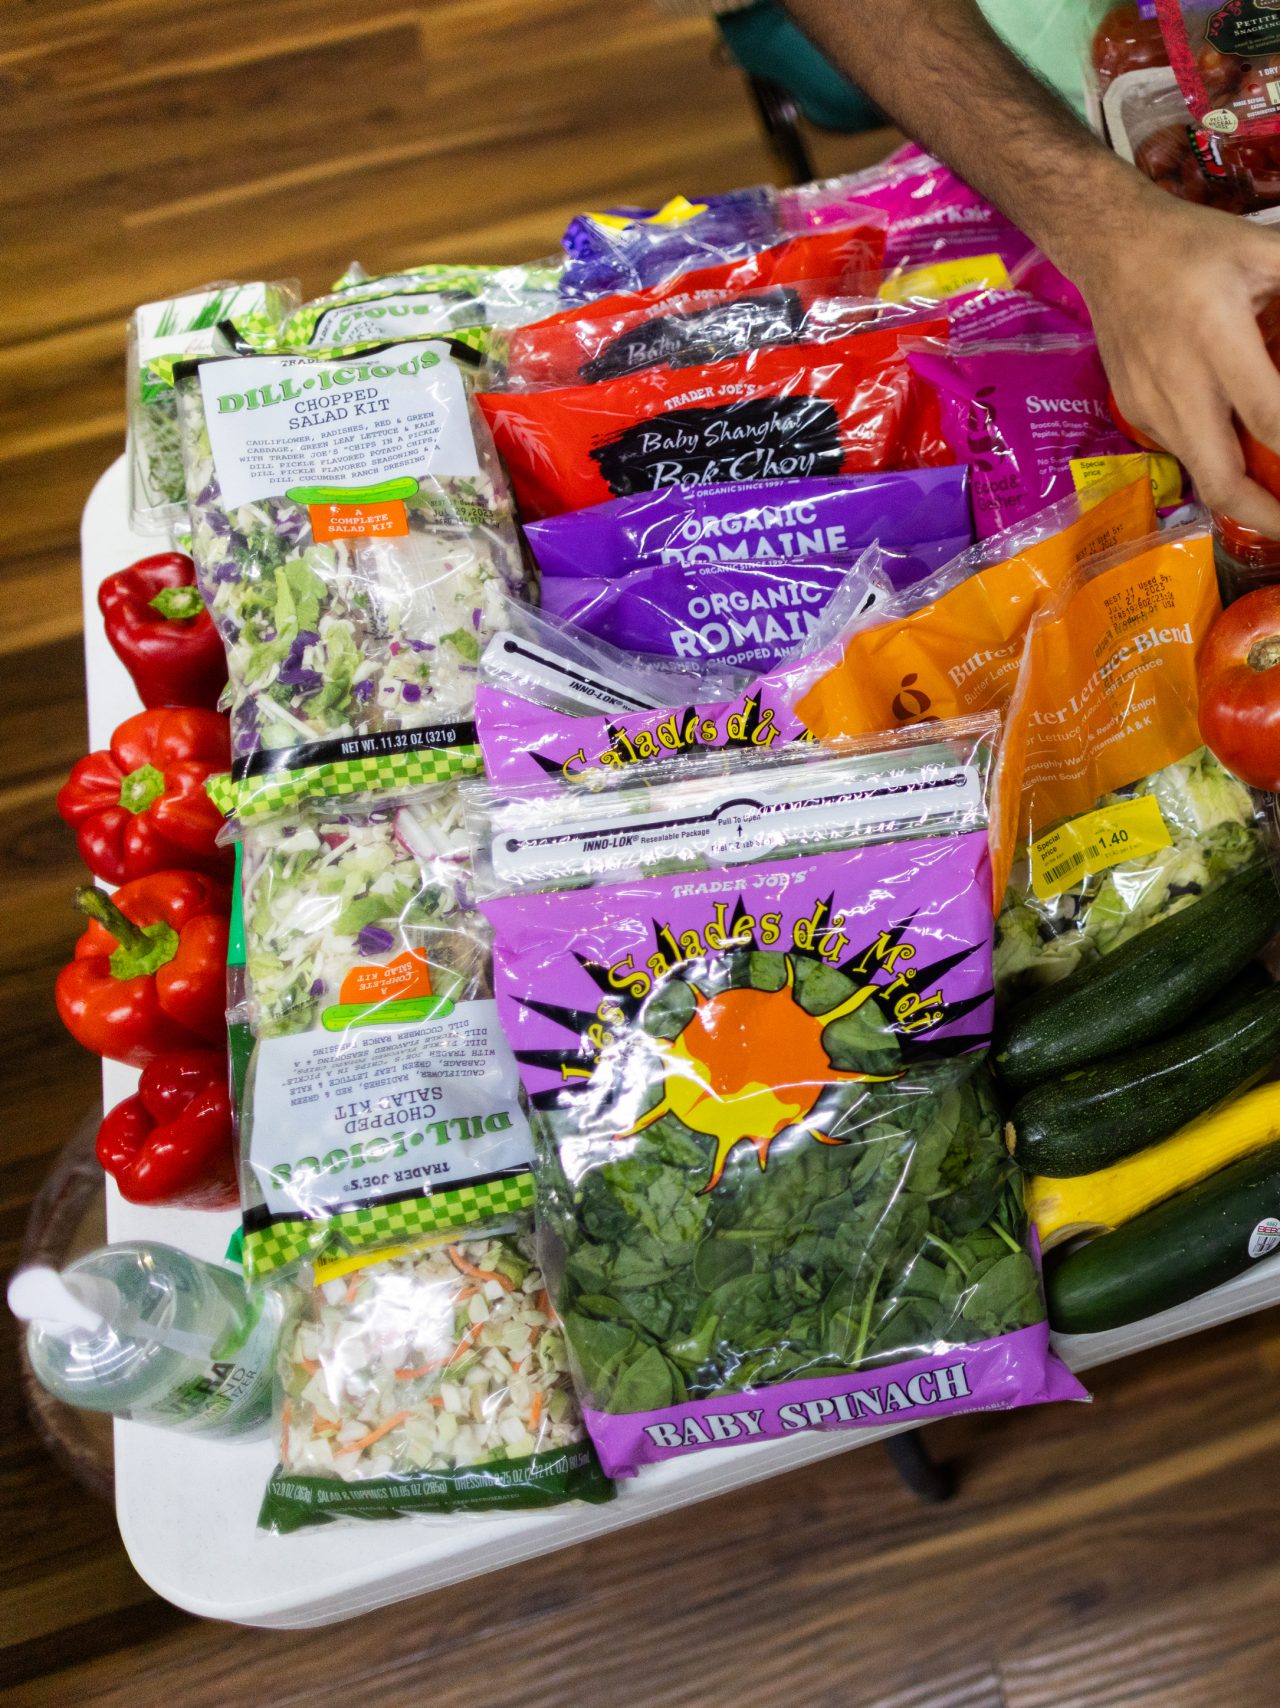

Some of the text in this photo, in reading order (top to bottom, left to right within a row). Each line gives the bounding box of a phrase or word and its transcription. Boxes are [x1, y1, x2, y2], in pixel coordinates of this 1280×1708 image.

[1236, 13, 1278, 28] PETITE
[1264, 67, 1278, 75] DRY
[294, 387, 378, 414] CHOPPED
[664, 386, 714, 410] TRADER
[1025, 395, 1091, 414] Sweet
[289, 399, 390, 430] SALAD KIT
[246, 411, 434, 446] CAULIFLOWER, RADISHES, RED GREEN
[247, 420, 436, 455] CABBAGE, GREEN LEAF LETTUCE KALE
[280, 460, 315, 468] PICKLE
[321, 452, 365, 465] FLAVORED
[370, 445, 402, 456] POTATO
[406, 436, 437, 448] CHIPS,
[310, 449, 339, 458] JOE'S
[382, 438, 394, 446] IN
[638, 429, 700, 453] Baby
[251, 449, 420, 478] DILL PICKLE FLAVORED SEASONING
[269, 455, 426, 484] DILL CUCUMBER RANCH DRESSING
[646, 459, 720, 491] Bok
[730, 448, 815, 481] Choy
[1080, 460, 1105, 469] Special
[697, 486, 736, 497] ORGANIC
[738, 483, 763, 491] SINCE
[765, 481, 784, 489] 1997
[328, 521, 393, 533] SALAD KIT
[330, 514, 389, 524] COMPLETE
[682, 503, 817, 541] ORGANIC
[1138, 577, 1157, 590] Used
[1145, 583, 1165, 596] 2023
[687, 580, 823, 619] ORGANIC
[670, 607, 830, 658] ROMAIN
[949, 641, 1018, 689] Butter
[1068, 623, 1194, 714] Lettuce Blend
[1121, 658, 1164, 684] Lettuce
[1131, 696, 1156, 713] Enjoy
[727, 696, 781, 747] du
[341, 729, 456, 754] NET WT. 11.32 OZ (321g)
[718, 815, 741, 826] Pull To
[641, 833, 679, 844] Resealable
[681, 828, 710, 839] Package
[1036, 833, 1060, 853] Special
[1098, 829, 1128, 849] 1.40
[1040, 845, 1058, 861] price
[671, 878, 748, 899] TRADER
[606, 902, 784, 1000] Salades
[794, 899, 850, 964] du
[357, 962, 412, 981] SALAD KIT
[360, 972, 412, 990] COMPLETE
[362, 1020, 469, 1046] DILL CUCUMBER RANCH
[465, 1028, 488, 1037] DILL
[375, 1039, 419, 1053] FLAVORED
[289, 1059, 486, 1095] CABBAGE, GREEN LEAF LETTUCE KALE
[291, 1069, 485, 1106] CAULIFLOWER, RADISHES, RED GREEN
[335, 1098, 377, 1120] KIT
[344, 1103, 436, 1134] CHOPPED
[395, 1161, 450, 1182] TRADER
[643, 1361, 973, 1450] BABY SPINACH
[411, 1485, 421, 1496] OZ
[513, 1472, 524, 1484] OZ
